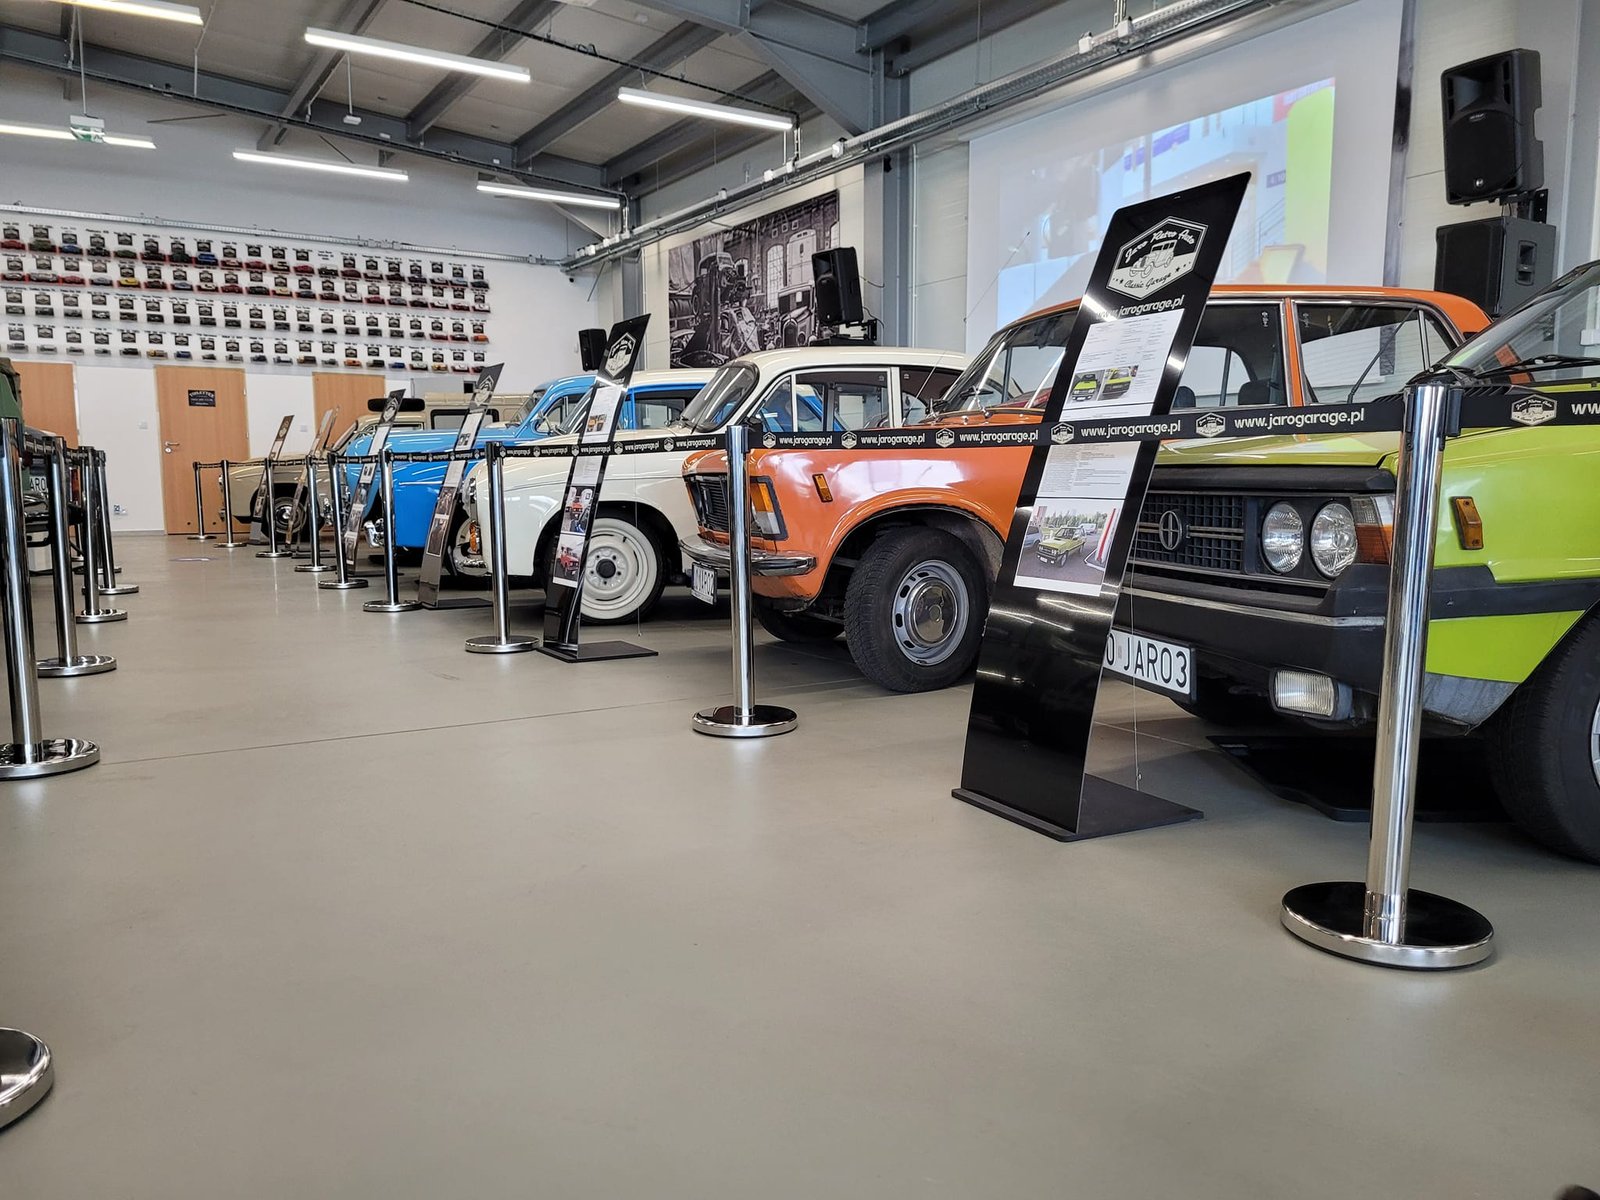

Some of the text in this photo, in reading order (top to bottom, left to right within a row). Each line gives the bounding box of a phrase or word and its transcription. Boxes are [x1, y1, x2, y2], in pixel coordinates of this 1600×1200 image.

[1125, 229, 1195, 263] Jaro Retro Auto
[1124, 272, 1171, 290] Classic Garage
[1234, 408, 1364, 430] www.jarogarage.pl
[959, 429, 1039, 444] www.jarogarage.pl
[1081, 420, 1181, 438] www.jarogarage.pl
[779, 435, 832, 446] www.jarogarage.pl
[860, 433, 925, 447] www.jarogarage.pl
